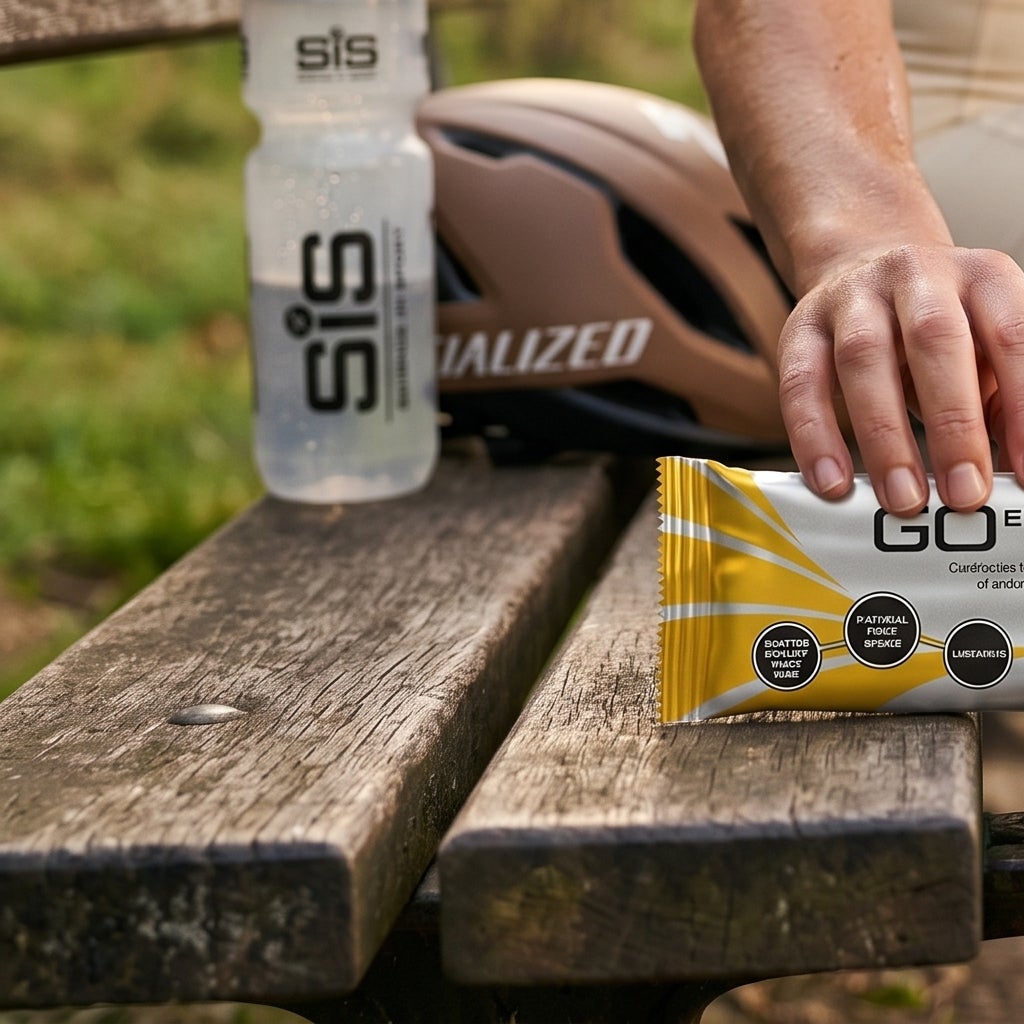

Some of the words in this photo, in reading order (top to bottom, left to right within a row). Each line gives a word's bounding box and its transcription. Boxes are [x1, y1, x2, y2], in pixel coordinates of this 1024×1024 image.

[436, 317, 654, 376] IALIZED
[874, 506, 997, 553] GO
[977, 578, 989, 589] of
